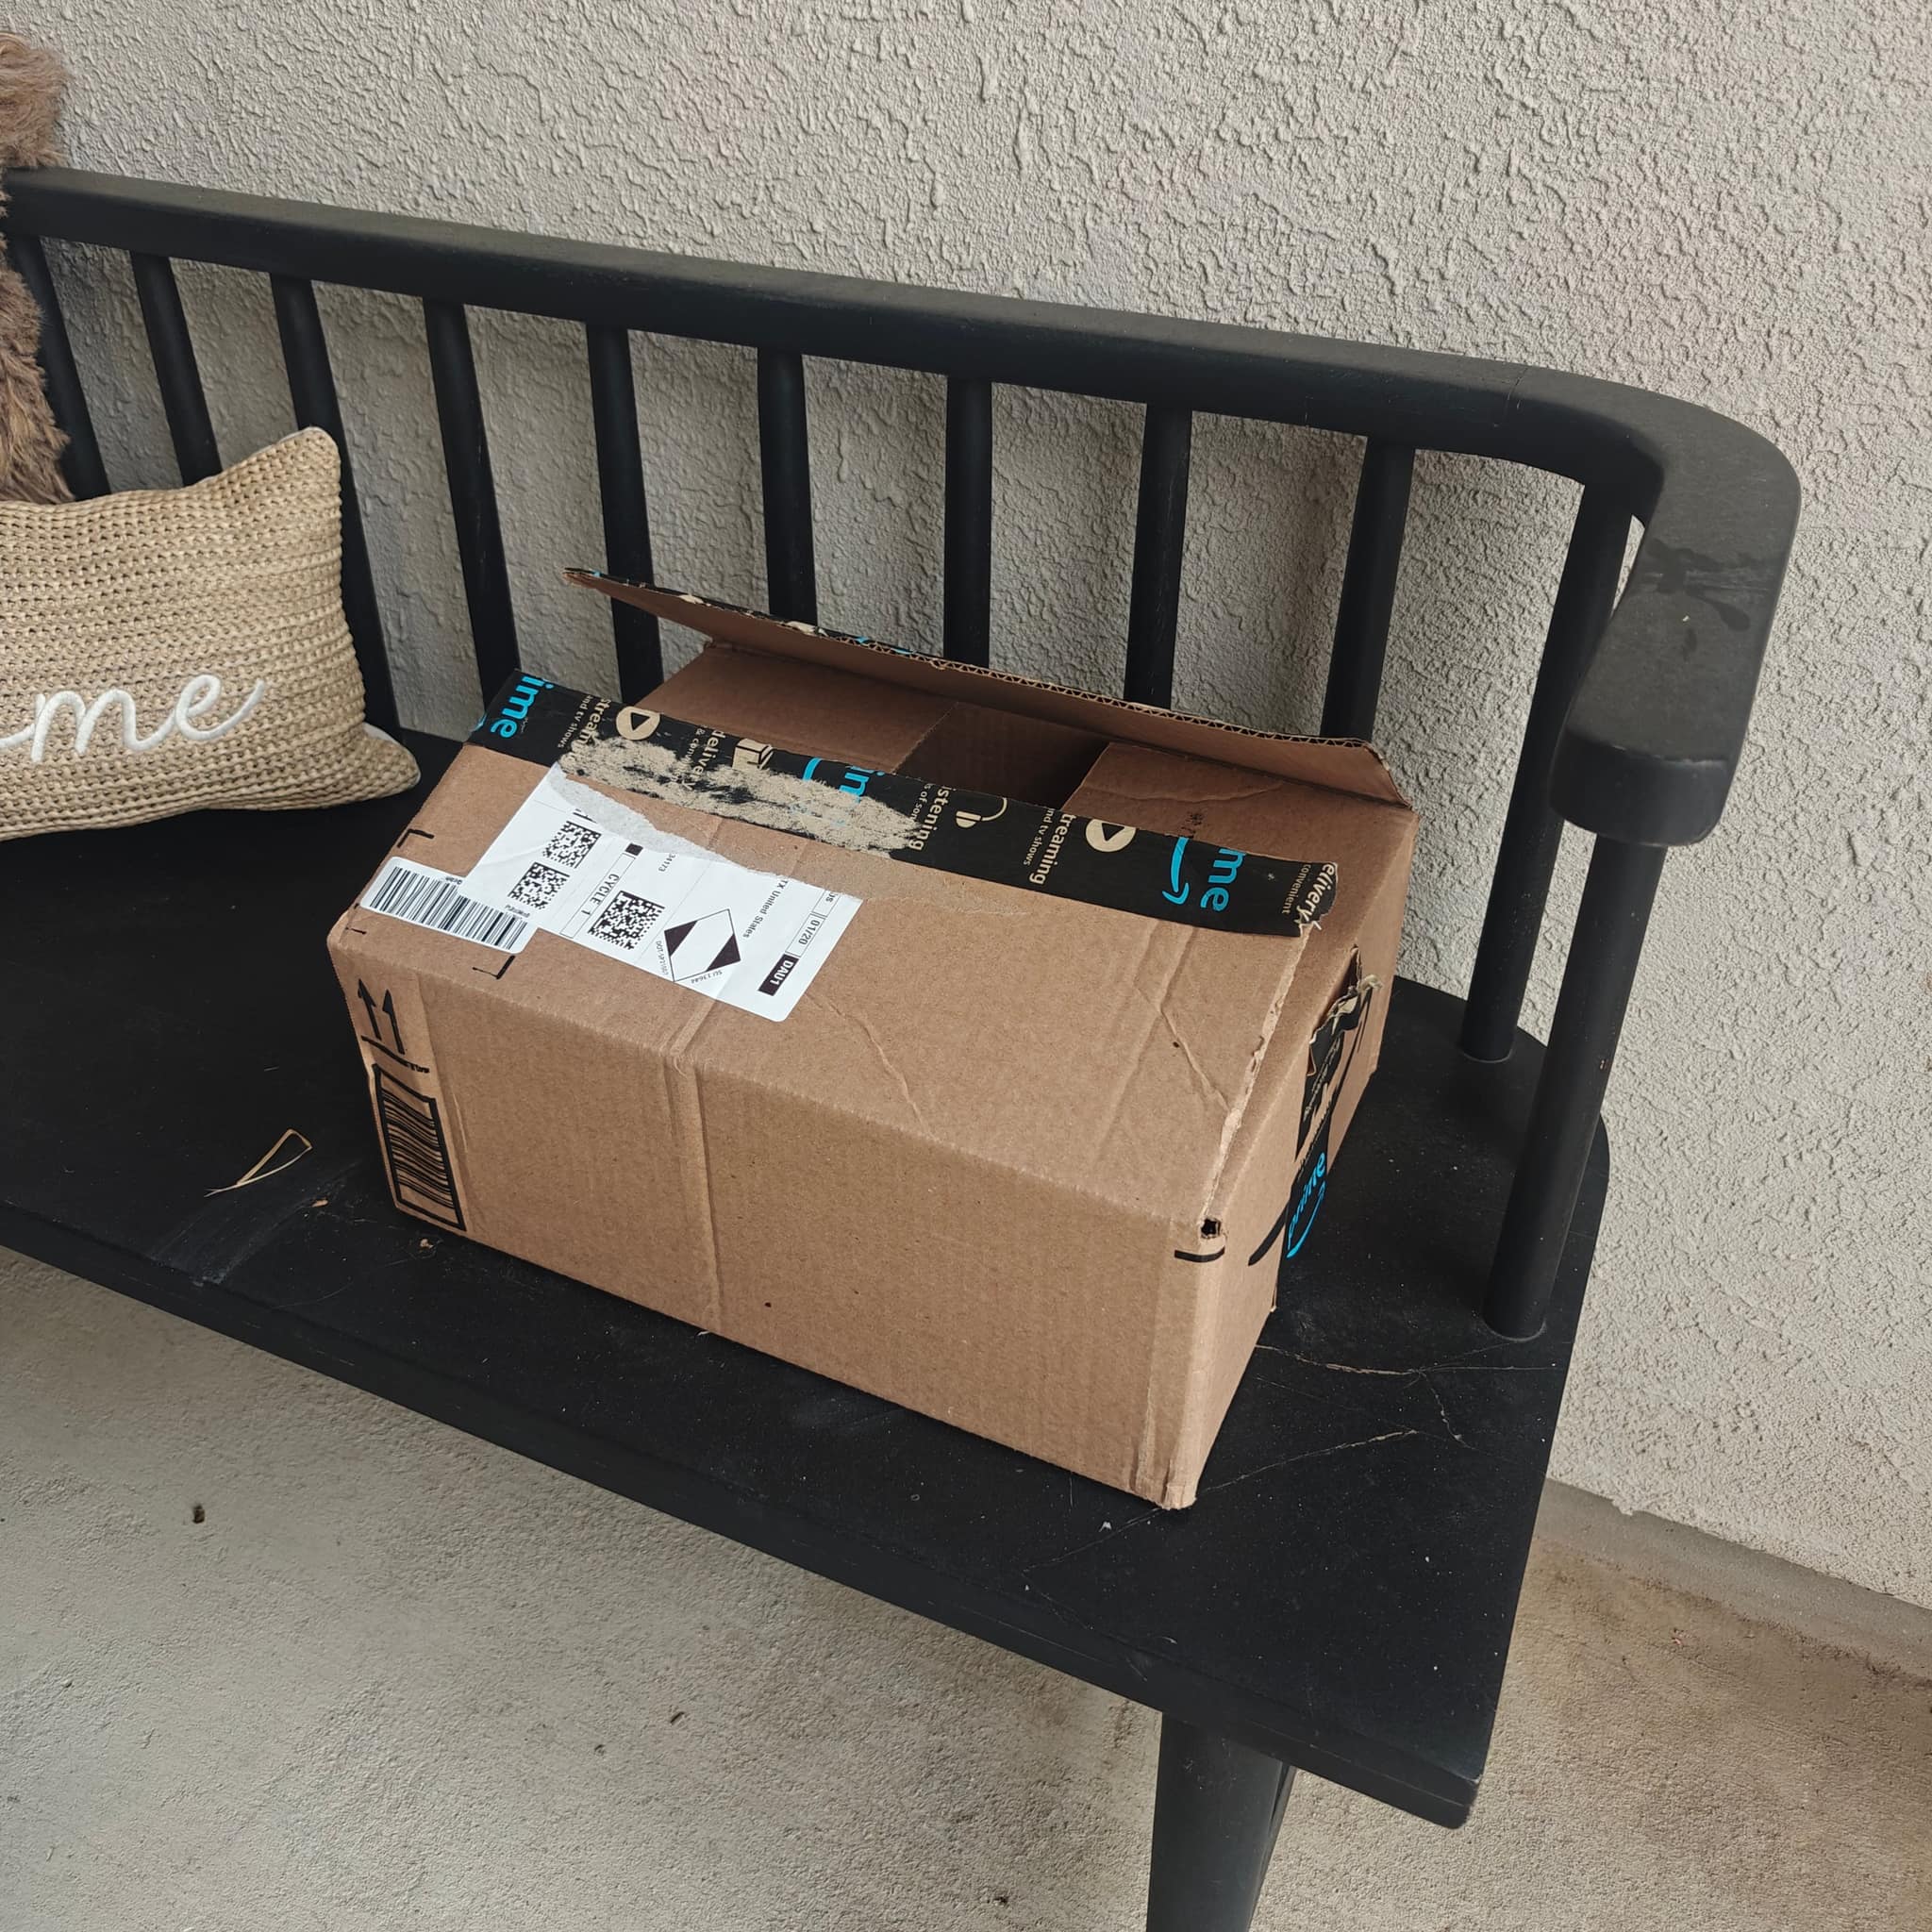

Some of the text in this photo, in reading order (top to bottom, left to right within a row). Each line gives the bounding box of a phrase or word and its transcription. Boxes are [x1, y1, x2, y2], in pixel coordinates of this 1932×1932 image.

[0, 674, 265, 764] me
[558, 723, 577, 748] shows
[1038, 825, 1049, 835] tv
[1023, 836, 1042, 866] shows
[1028, 813, 1076, 885] treaming
[590, 874, 620, 906] CYCLE
[758, 890, 782, 915] United
[742, 915, 764, 939] States
[798, 919, 821, 945] 01/20
[769, 959, 794, 986] DAU1
